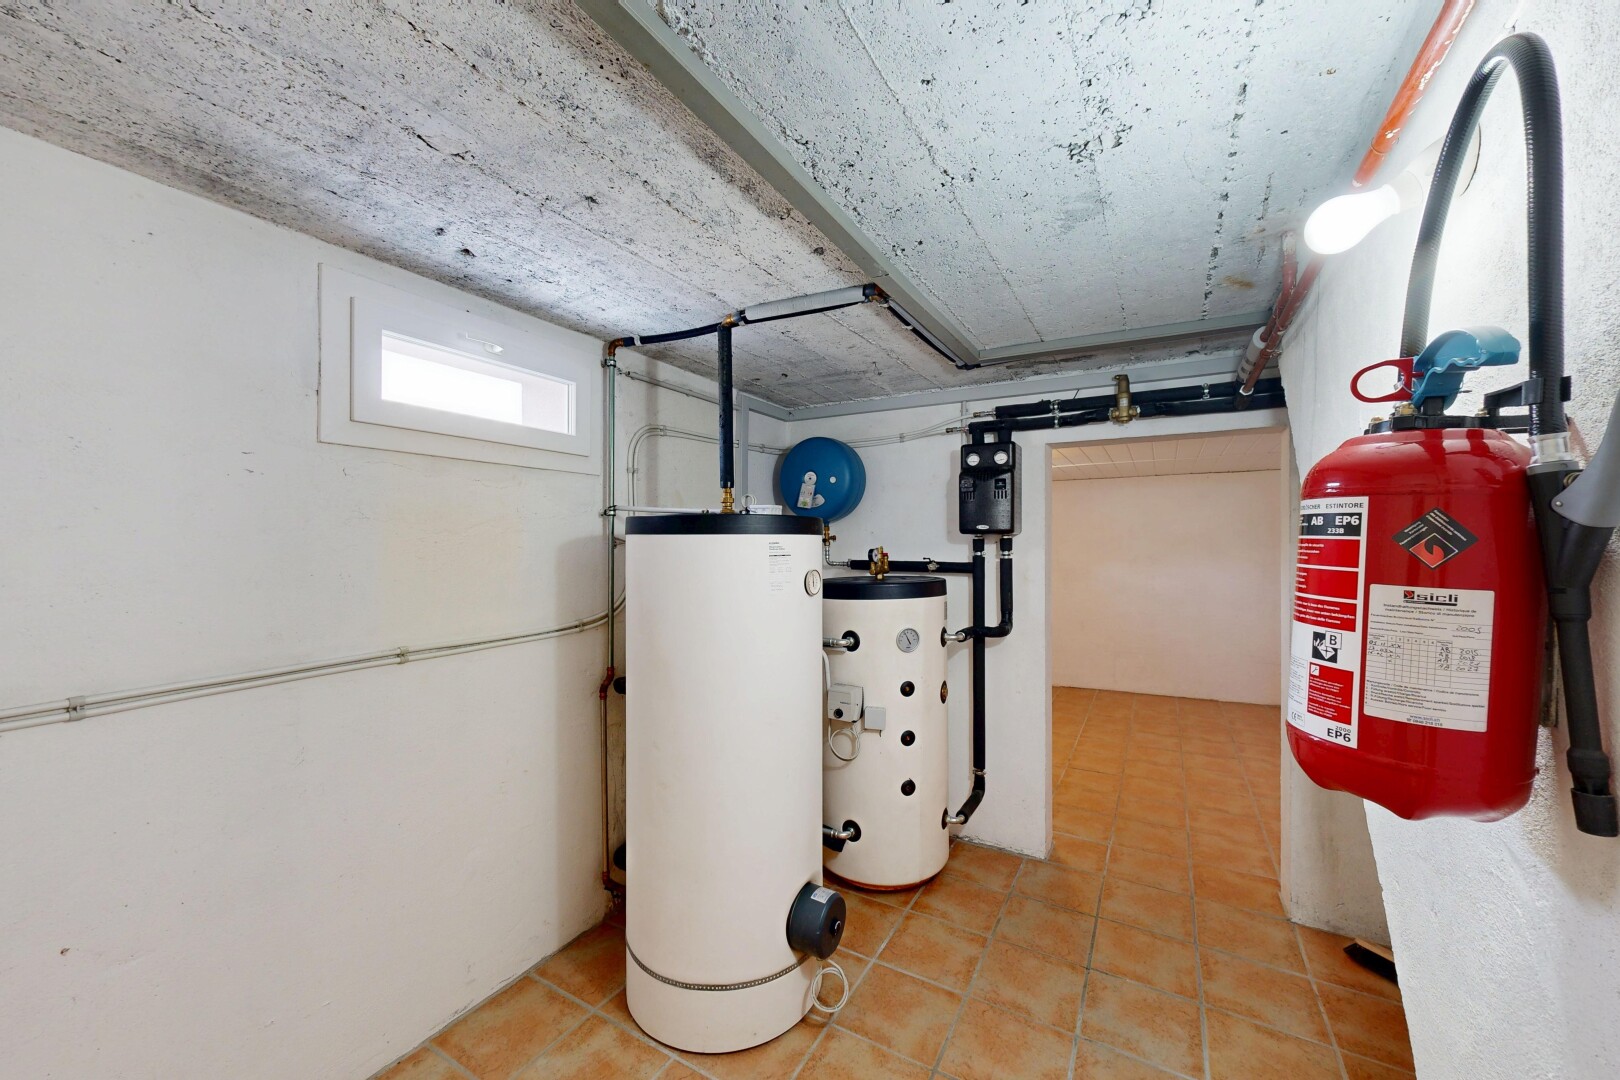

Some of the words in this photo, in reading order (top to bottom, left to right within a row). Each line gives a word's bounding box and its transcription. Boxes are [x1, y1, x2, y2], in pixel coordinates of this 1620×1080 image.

[1311, 516, 1324, 526] AB
[1335, 515, 1360, 526] EP6
[1416, 593, 1459, 603] sicli
[1329, 635, 1337, 646] B
[1327, 728, 1351, 743] EP6
